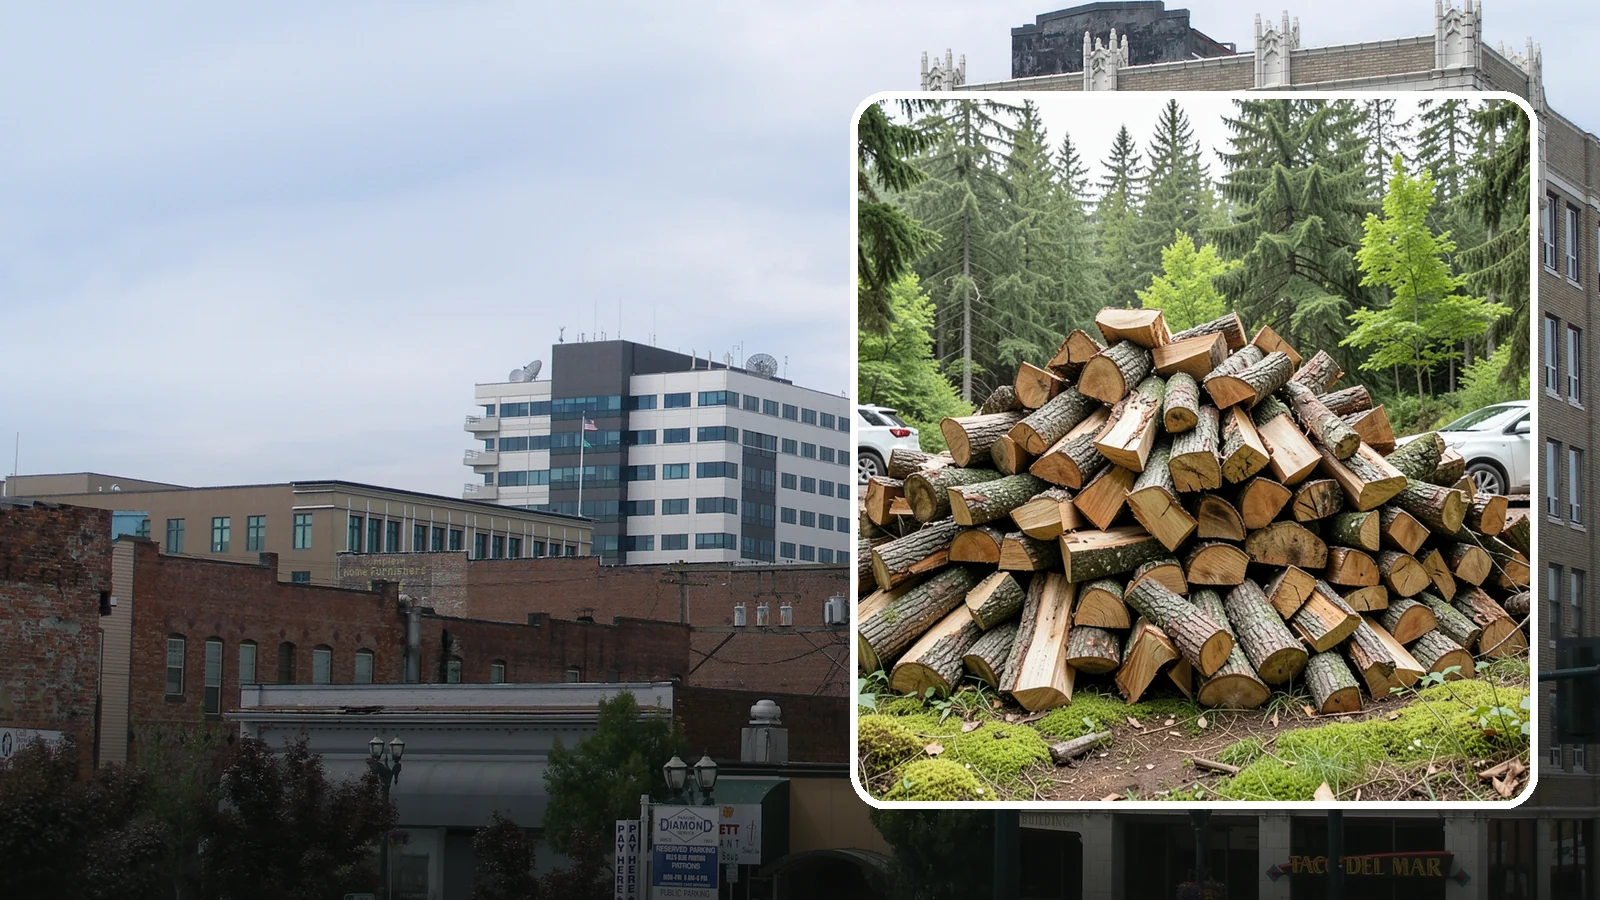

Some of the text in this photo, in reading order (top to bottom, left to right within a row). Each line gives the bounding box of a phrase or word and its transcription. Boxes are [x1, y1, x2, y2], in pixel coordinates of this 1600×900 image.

[343, 566, 427, 577] Home Furnishers
[660, 818, 713, 833] DIAMOND
[1022, 815, 1069, 828] BUILDING
[656, 845, 716, 854] RESERVED PARKING
[616, 824, 625, 894] PAY HERE
[627, 824, 637, 894] PAY HERE
[722, 851, 739, 863] Soup
[671, 862, 701, 870] PATRONS
[1345, 856, 1385, 876] DEL
[1392, 857, 1443, 877] MAR
[660, 888, 710, 898] PUBLIC PARKING
